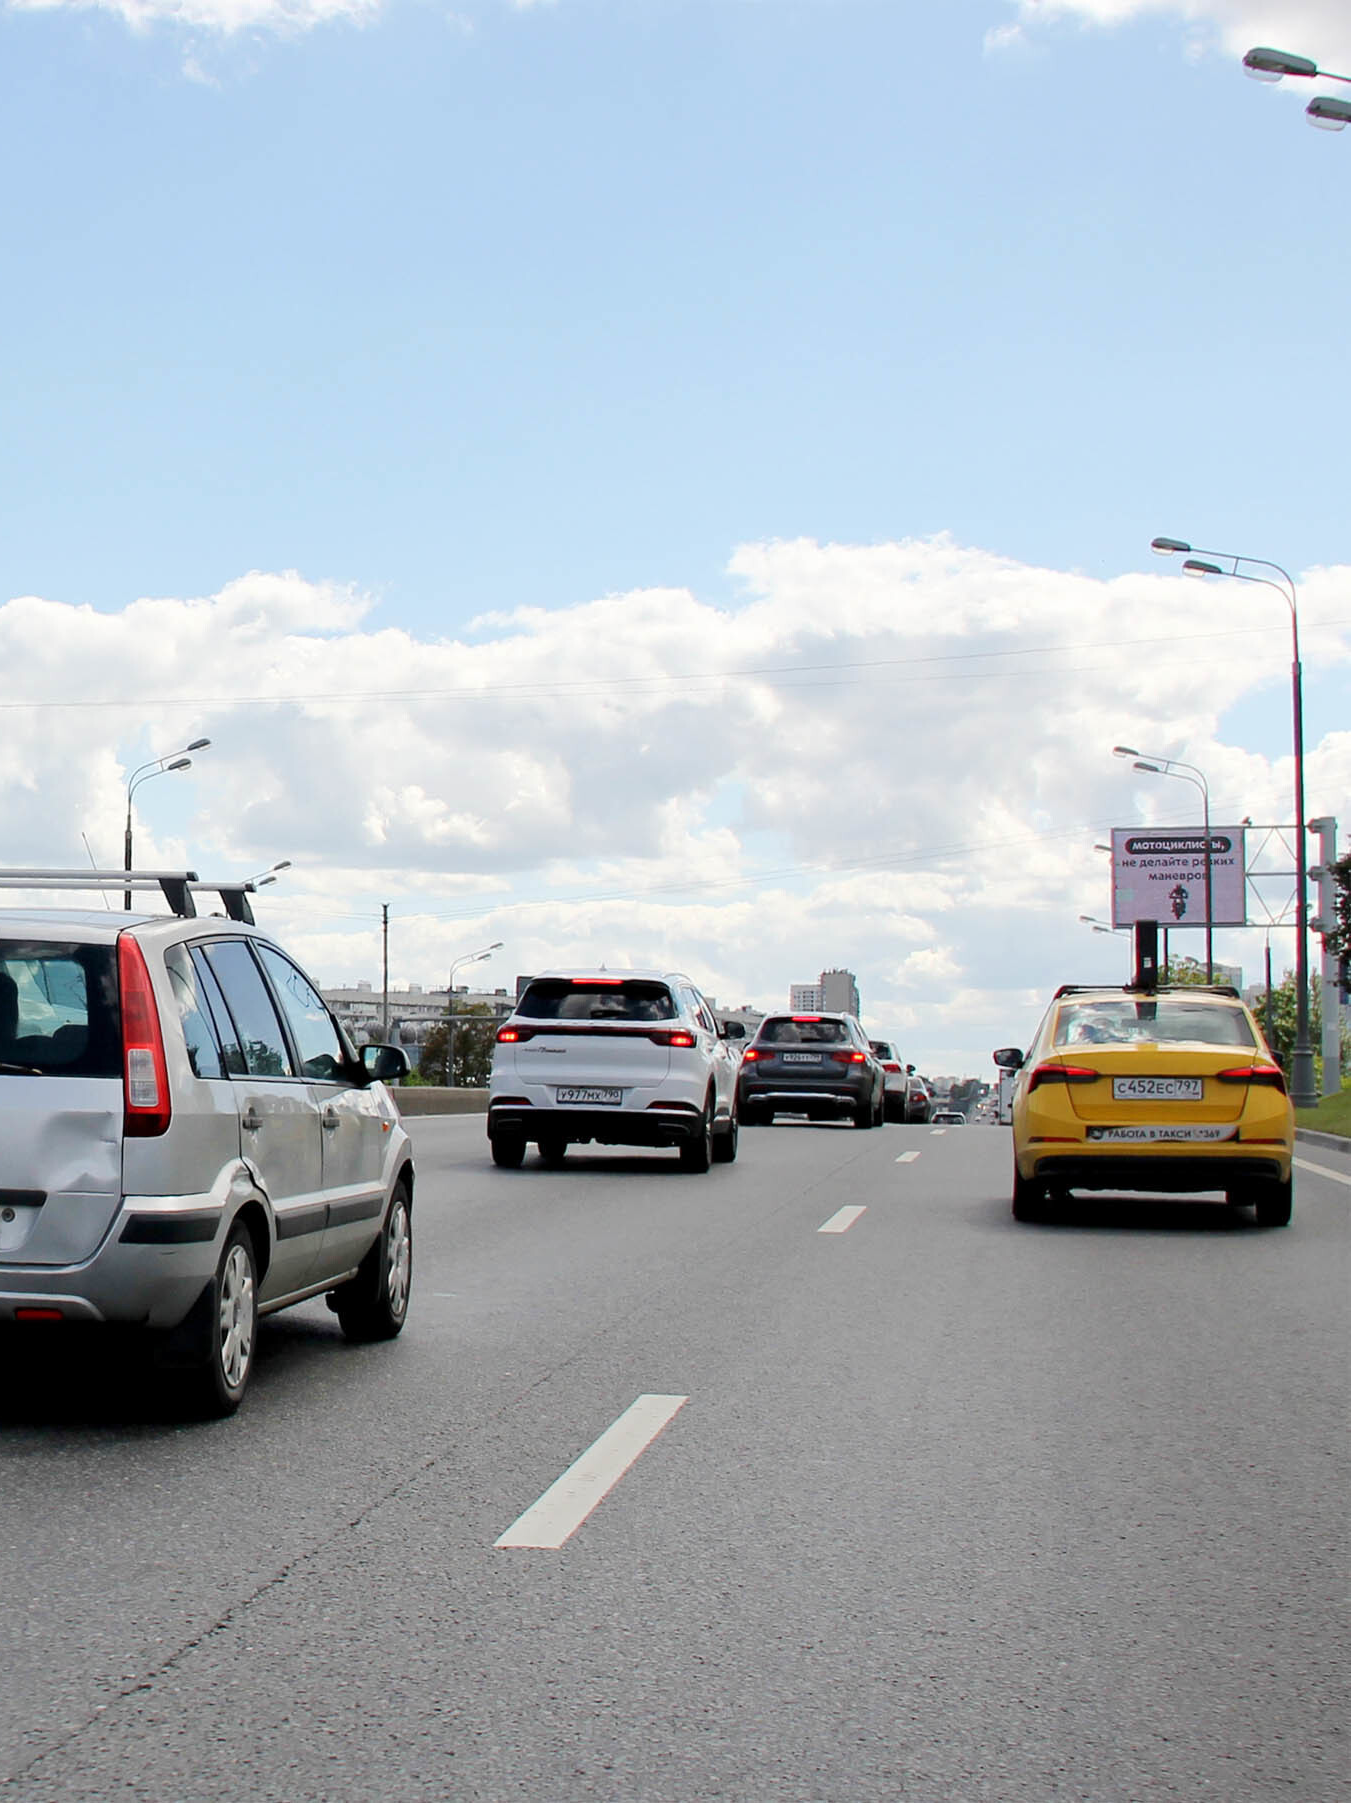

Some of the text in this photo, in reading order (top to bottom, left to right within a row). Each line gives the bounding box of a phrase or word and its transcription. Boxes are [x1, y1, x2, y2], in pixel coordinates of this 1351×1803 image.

[1122, 859, 1136, 867] не
[1139, 857, 1188, 868] делайте
[1117, 1080, 1199, 1094] С452ЕС 797
[1108, 1129, 1146, 1138] РАБОТА
[1159, 1129, 1191, 1138] ТАКСИ
